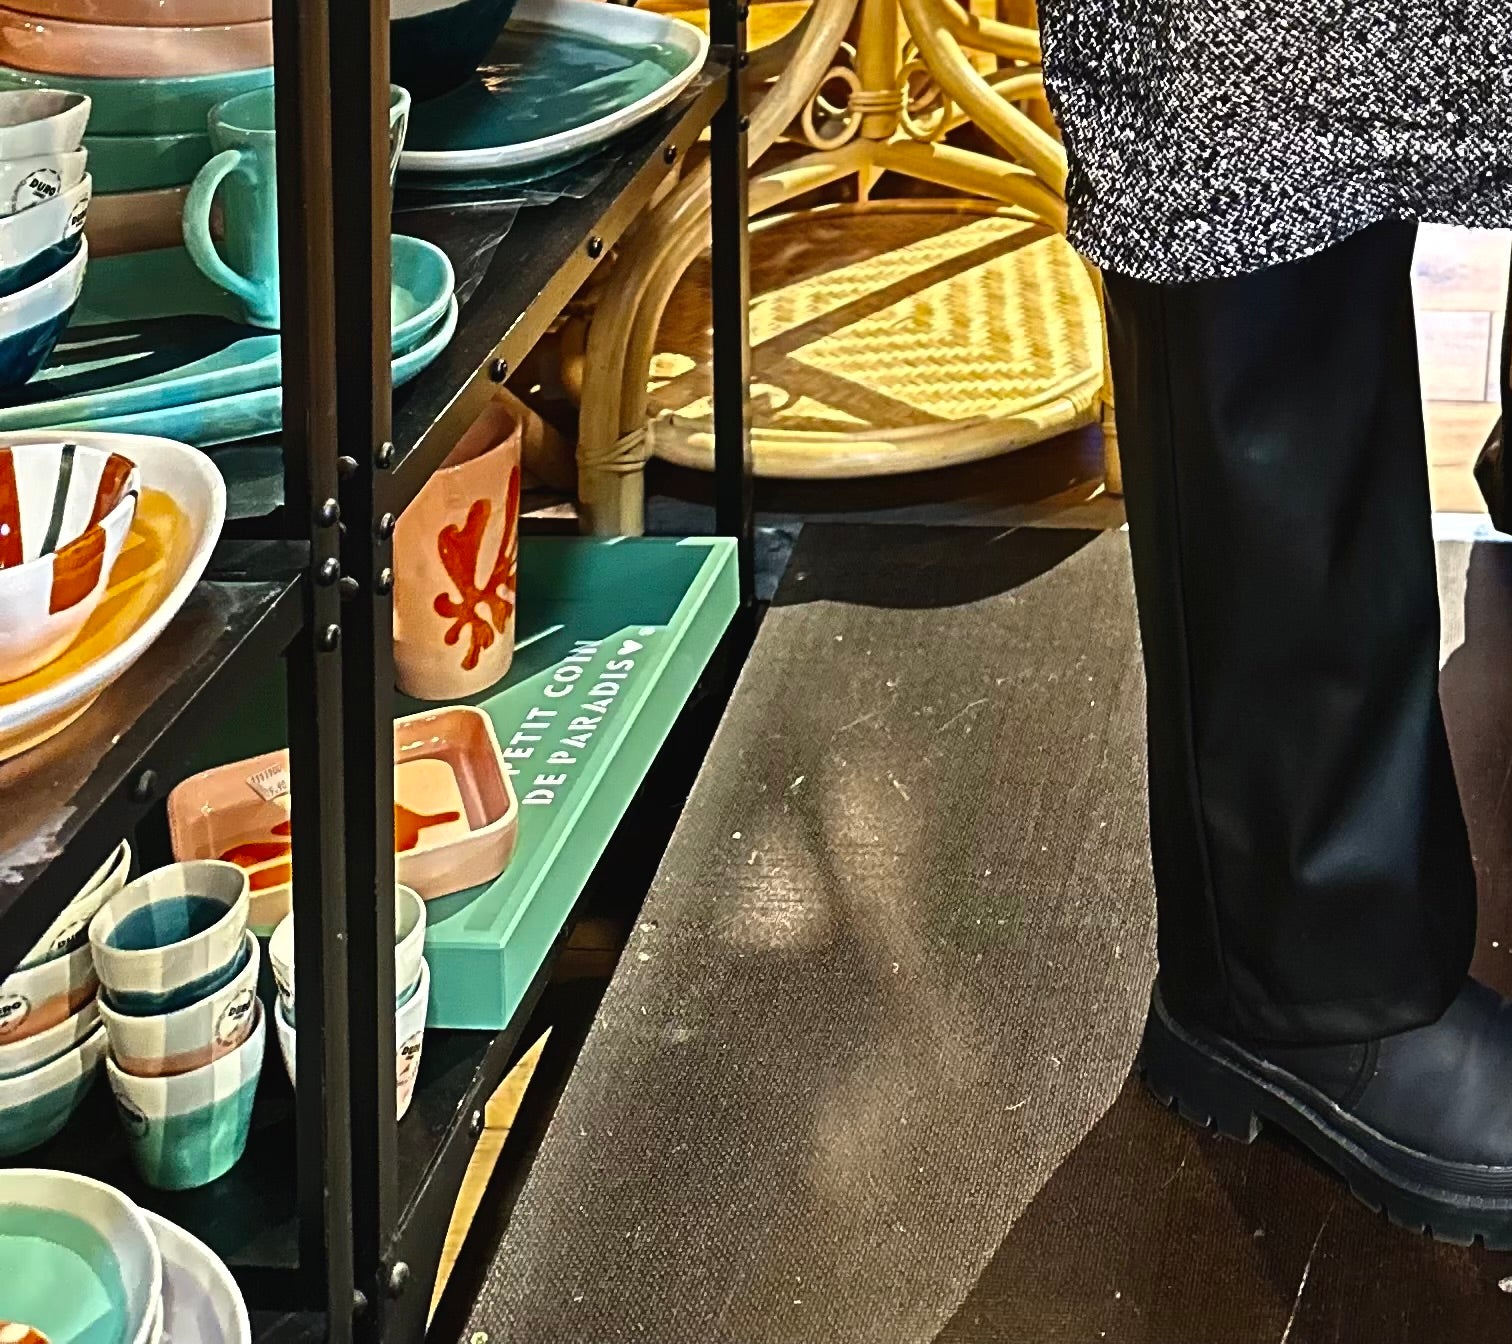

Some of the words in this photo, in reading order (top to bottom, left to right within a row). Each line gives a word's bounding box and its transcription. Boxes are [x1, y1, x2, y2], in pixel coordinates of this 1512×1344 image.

[29, 178, 57, 197] DURO
[543, 640, 603, 698] COIN
[522, 773, 568, 805] DE
[546, 659, 635, 764] PARADIS
